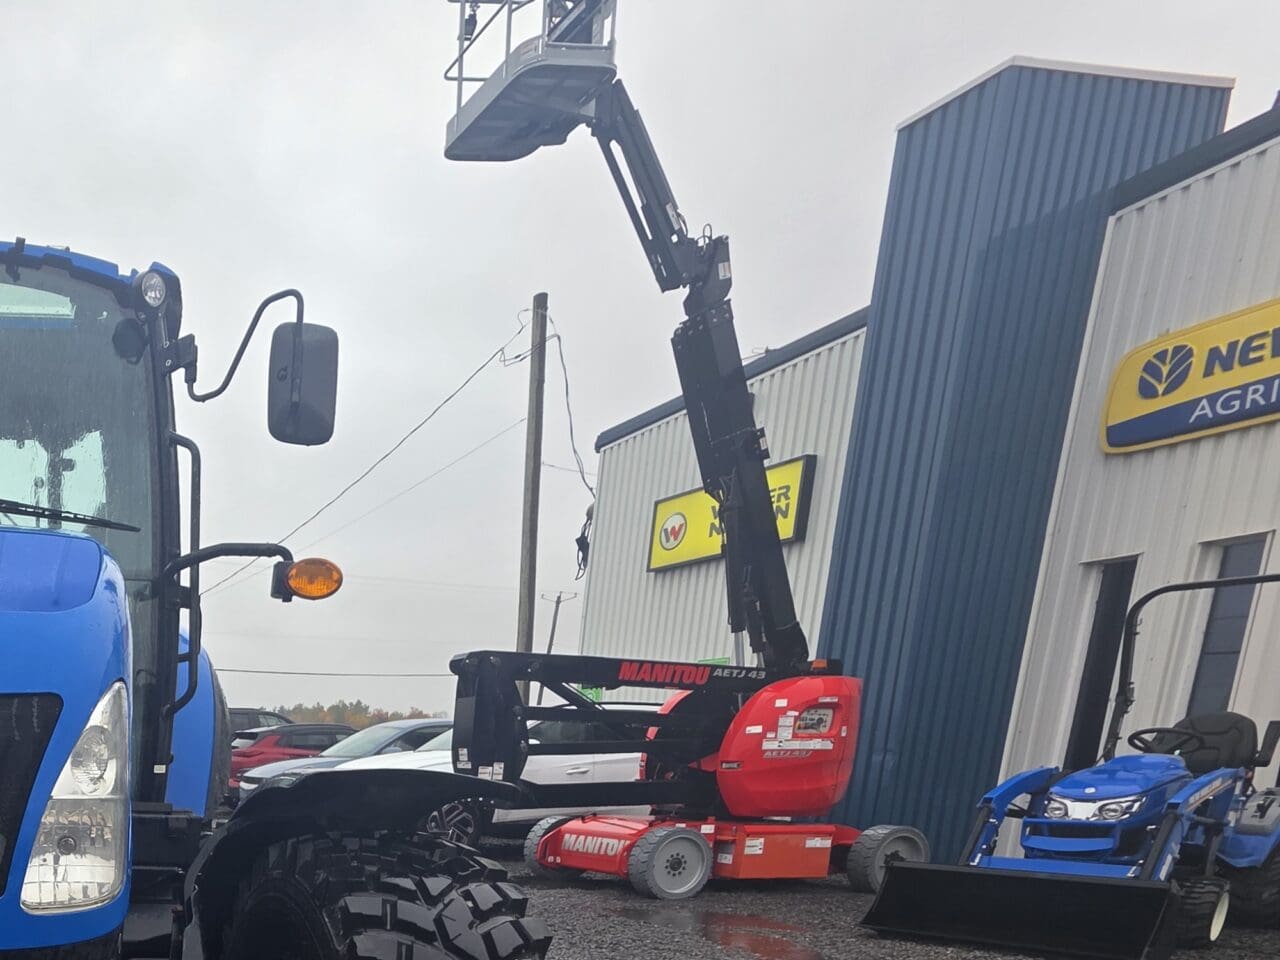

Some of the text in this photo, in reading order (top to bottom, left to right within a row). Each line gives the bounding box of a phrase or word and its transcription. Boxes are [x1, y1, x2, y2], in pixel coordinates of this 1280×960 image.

[1188, 378, 1280, 423] AGRI
[618, 661, 767, 685] MANITOU AETJ 43
